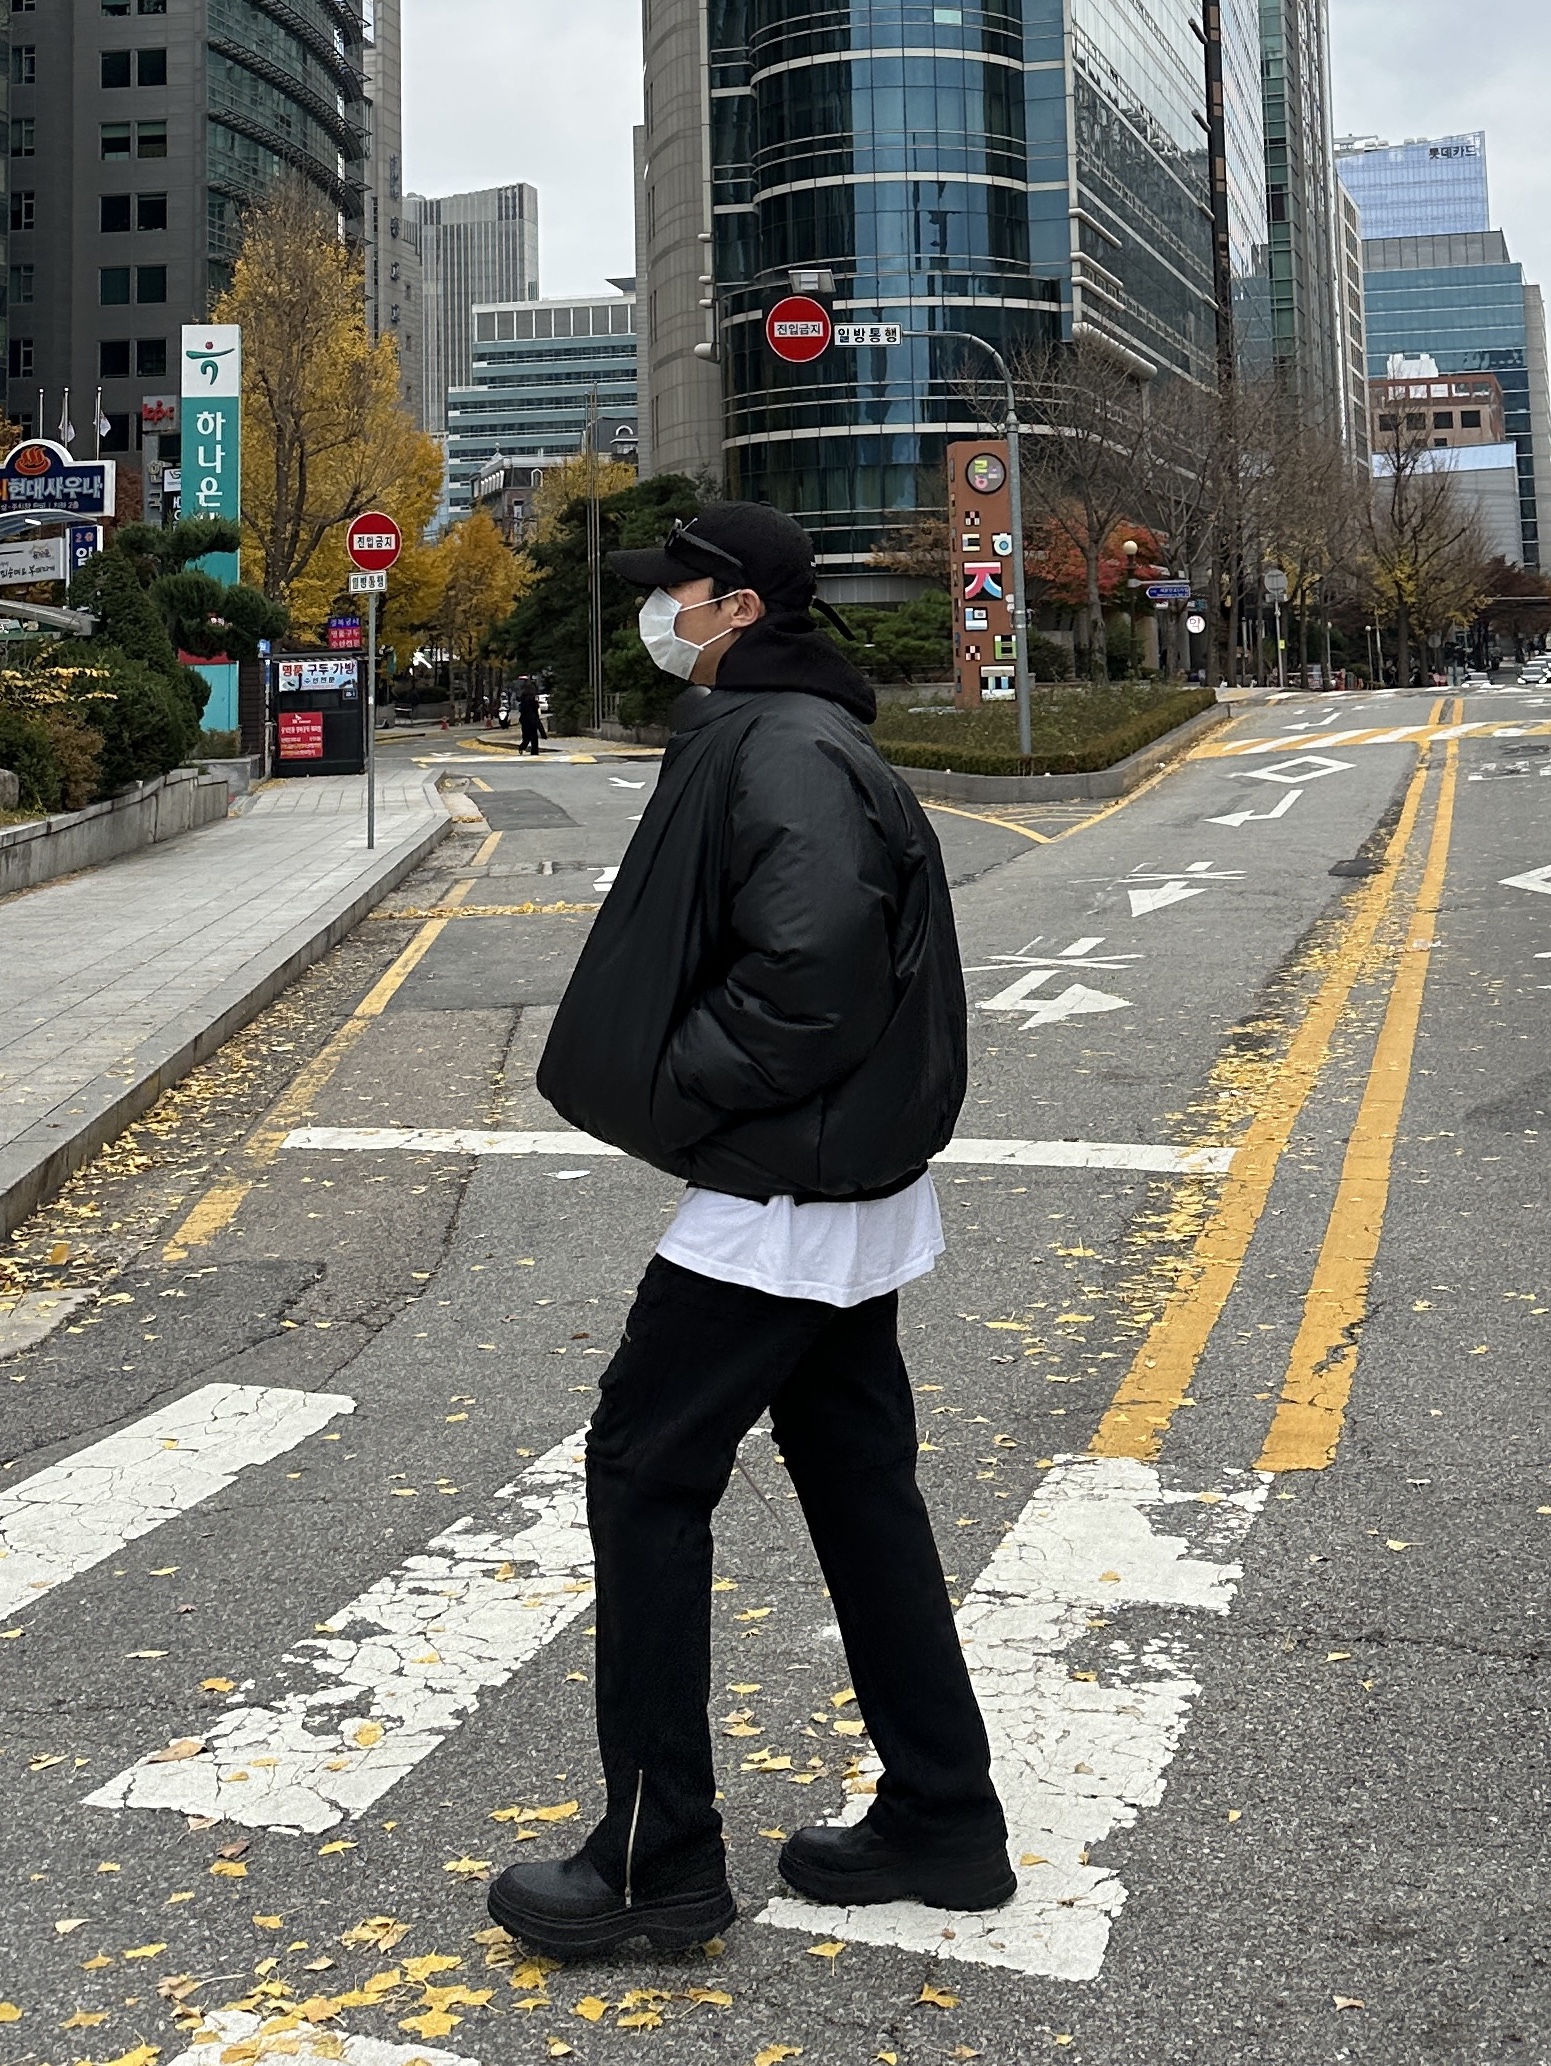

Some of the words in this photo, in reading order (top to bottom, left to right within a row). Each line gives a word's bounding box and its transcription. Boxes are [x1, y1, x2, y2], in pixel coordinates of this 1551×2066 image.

[1429, 145, 1476, 159] 롯데카드
[777, 324, 820, 335] 진입금지
[838, 327, 897, 343] 일방통행
[196, 411, 226, 520] 하나은
[8, 475, 102, 500] 현대사우나
[357, 536, 392, 548] 진입금지
